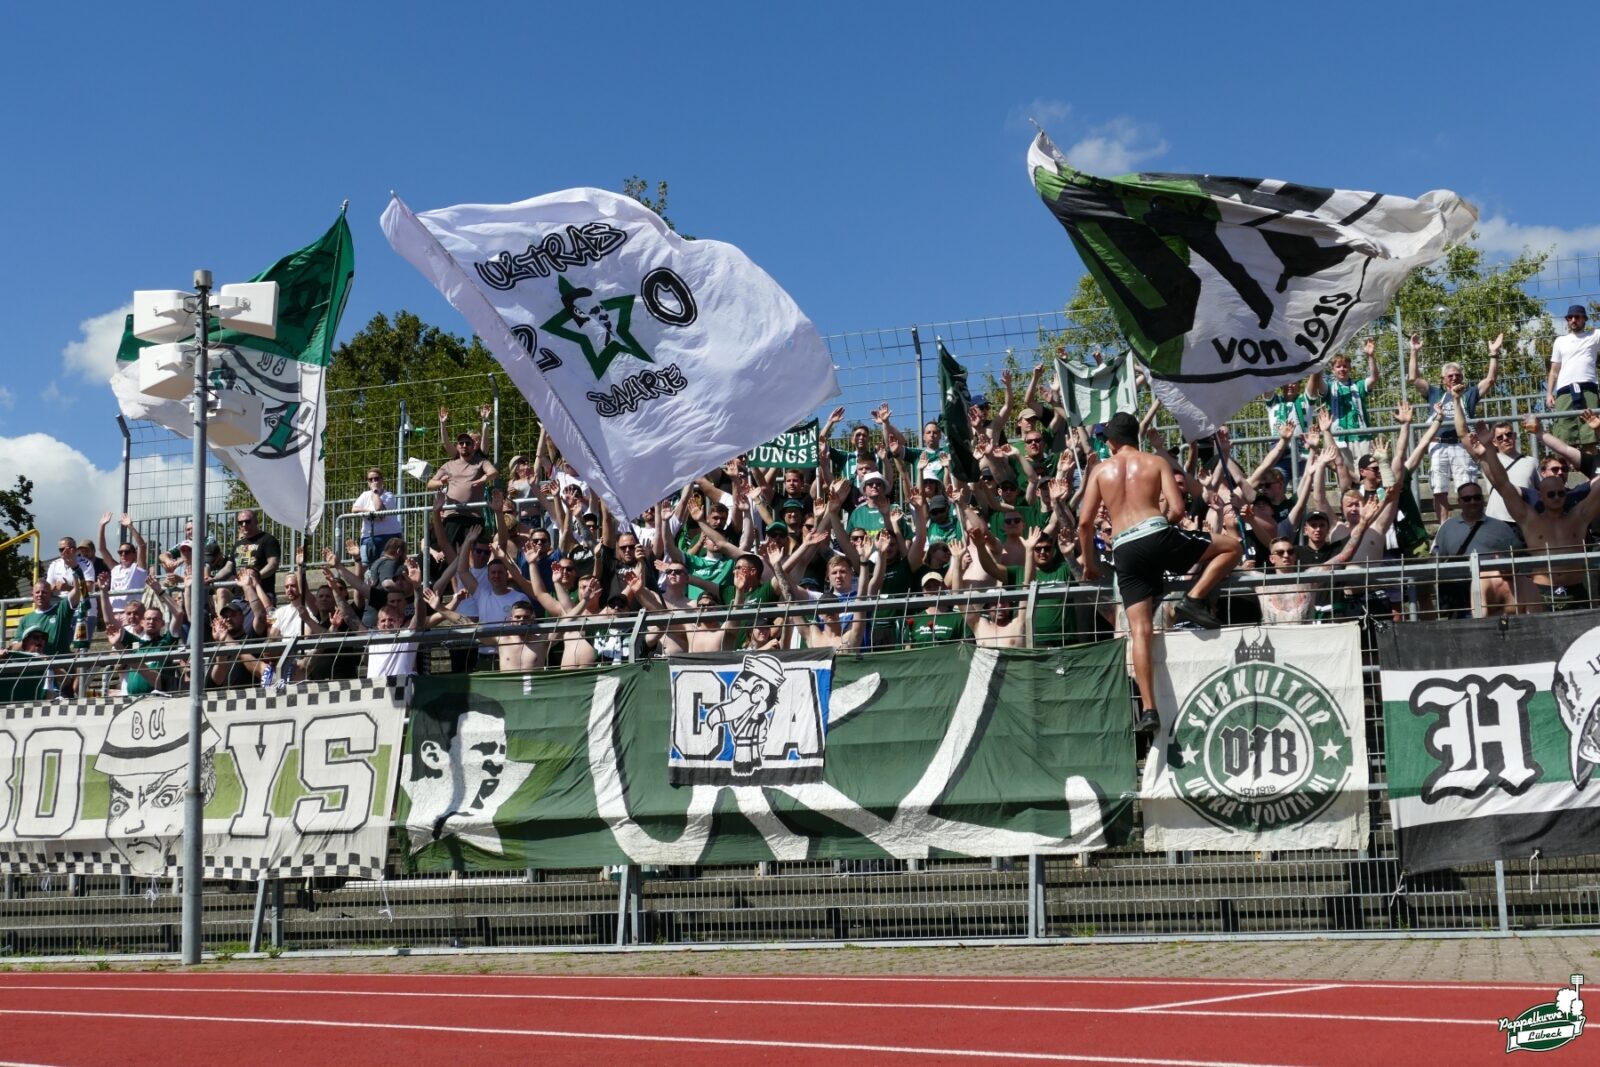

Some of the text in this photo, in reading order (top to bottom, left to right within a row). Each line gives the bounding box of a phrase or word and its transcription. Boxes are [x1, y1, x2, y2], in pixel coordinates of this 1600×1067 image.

[474, 222, 627, 290] ULTRAS
[1295, 292, 1353, 355] 1919
[749, 446, 808, 464] JUNGS
[1187, 669, 1332, 732] SUBKULTUR
[1251, 792, 1315, 824] YOUTH
[1307, 774, 1338, 795] HL
